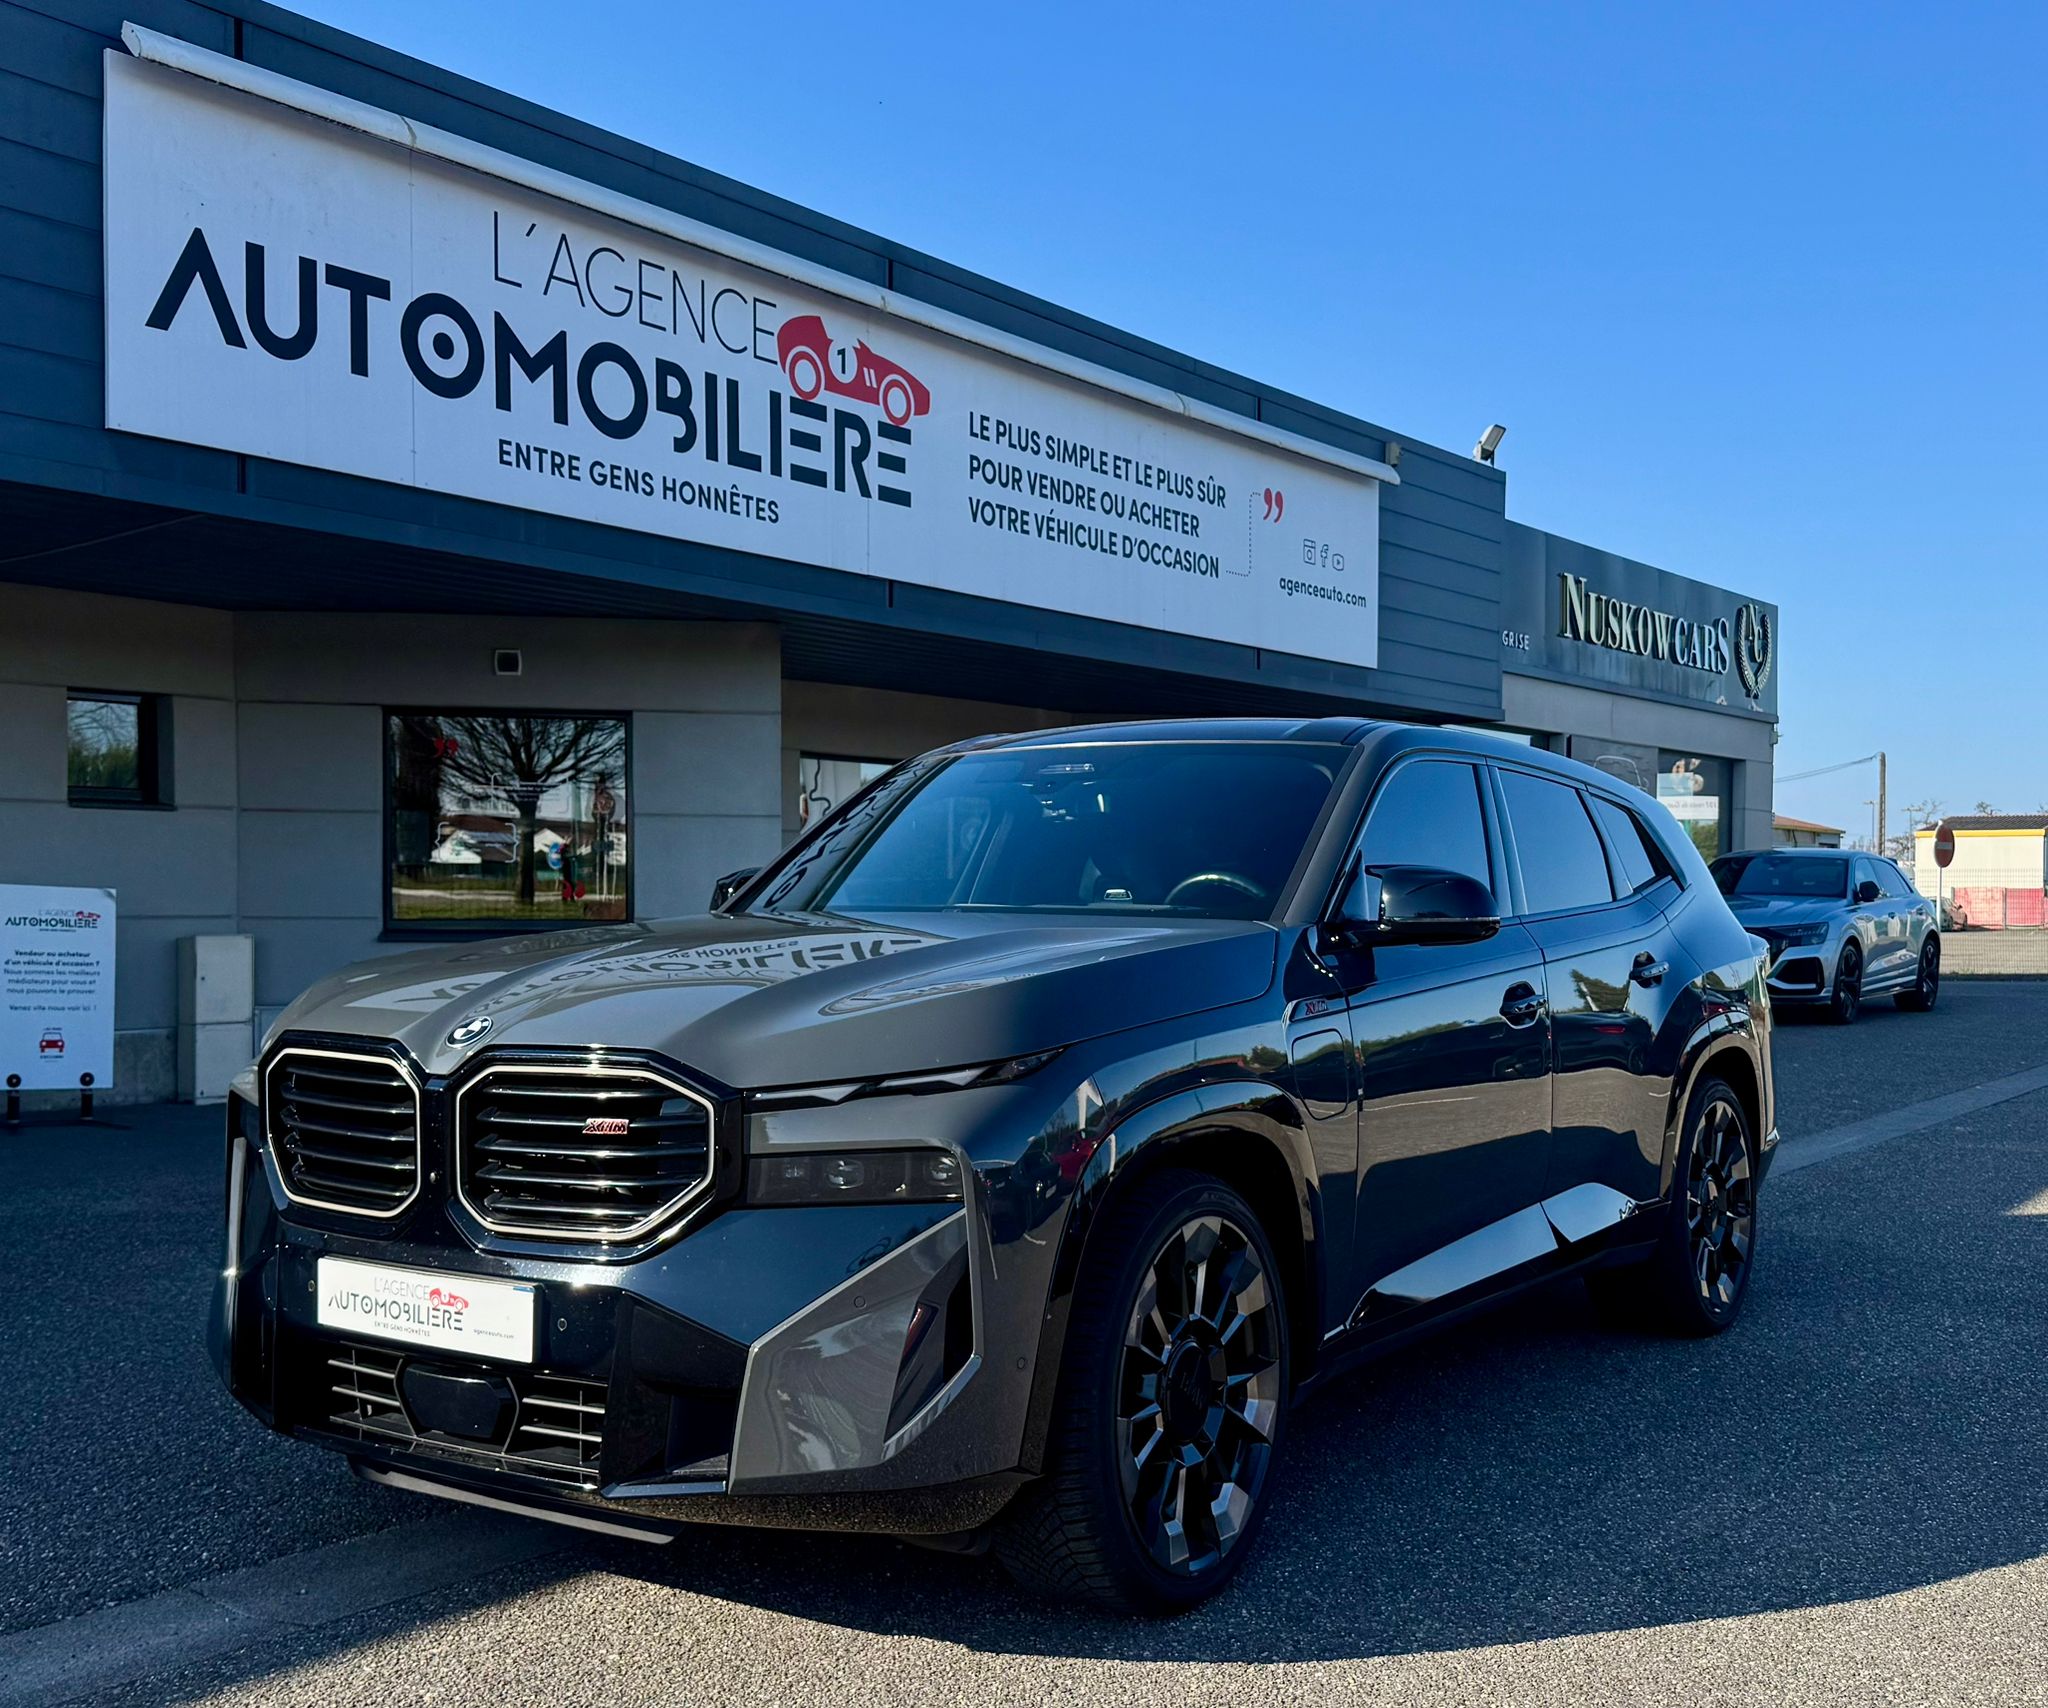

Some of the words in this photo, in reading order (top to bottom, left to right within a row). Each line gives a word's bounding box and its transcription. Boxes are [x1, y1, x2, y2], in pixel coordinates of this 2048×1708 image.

[491, 209, 779, 365] L'AGENCE
[837, 347, 846, 375] 1
[498, 438, 582, 483] ENTRE
[589, 459, 656, 499] GENS
[662, 472, 780, 525] HONNÊTES
[969, 411, 990, 442] LE
[995, 419, 1041, 456] PLUS
[1045, 435, 1109, 474] SIMPLE
[1113, 454, 1133, 482] ET
[1135, 461, 1153, 489] LE
[1157, 468, 1194, 499] PLUS
[1197, 475, 1227, 509] SÛR
[969, 454, 1023, 493] POUR
[1028, 469, 1096, 511] VENDRE
[1100, 490, 1125, 518] OU
[1128, 497, 1200, 538] ACHETER
[968, 496, 1030, 536] VOTRE
[1034, 508, 1118, 557] VÉHICULE
[1122, 537, 1220, 579] D'OCCASION
[1279, 576, 1367, 608] agenceauto.com
[1502, 630, 1530, 651] GRISE
[14, 949, 45, 957] Vendeur
[58, 950, 91, 958] acheteur
[374, 1276, 431, 1301] L'AGENCE
